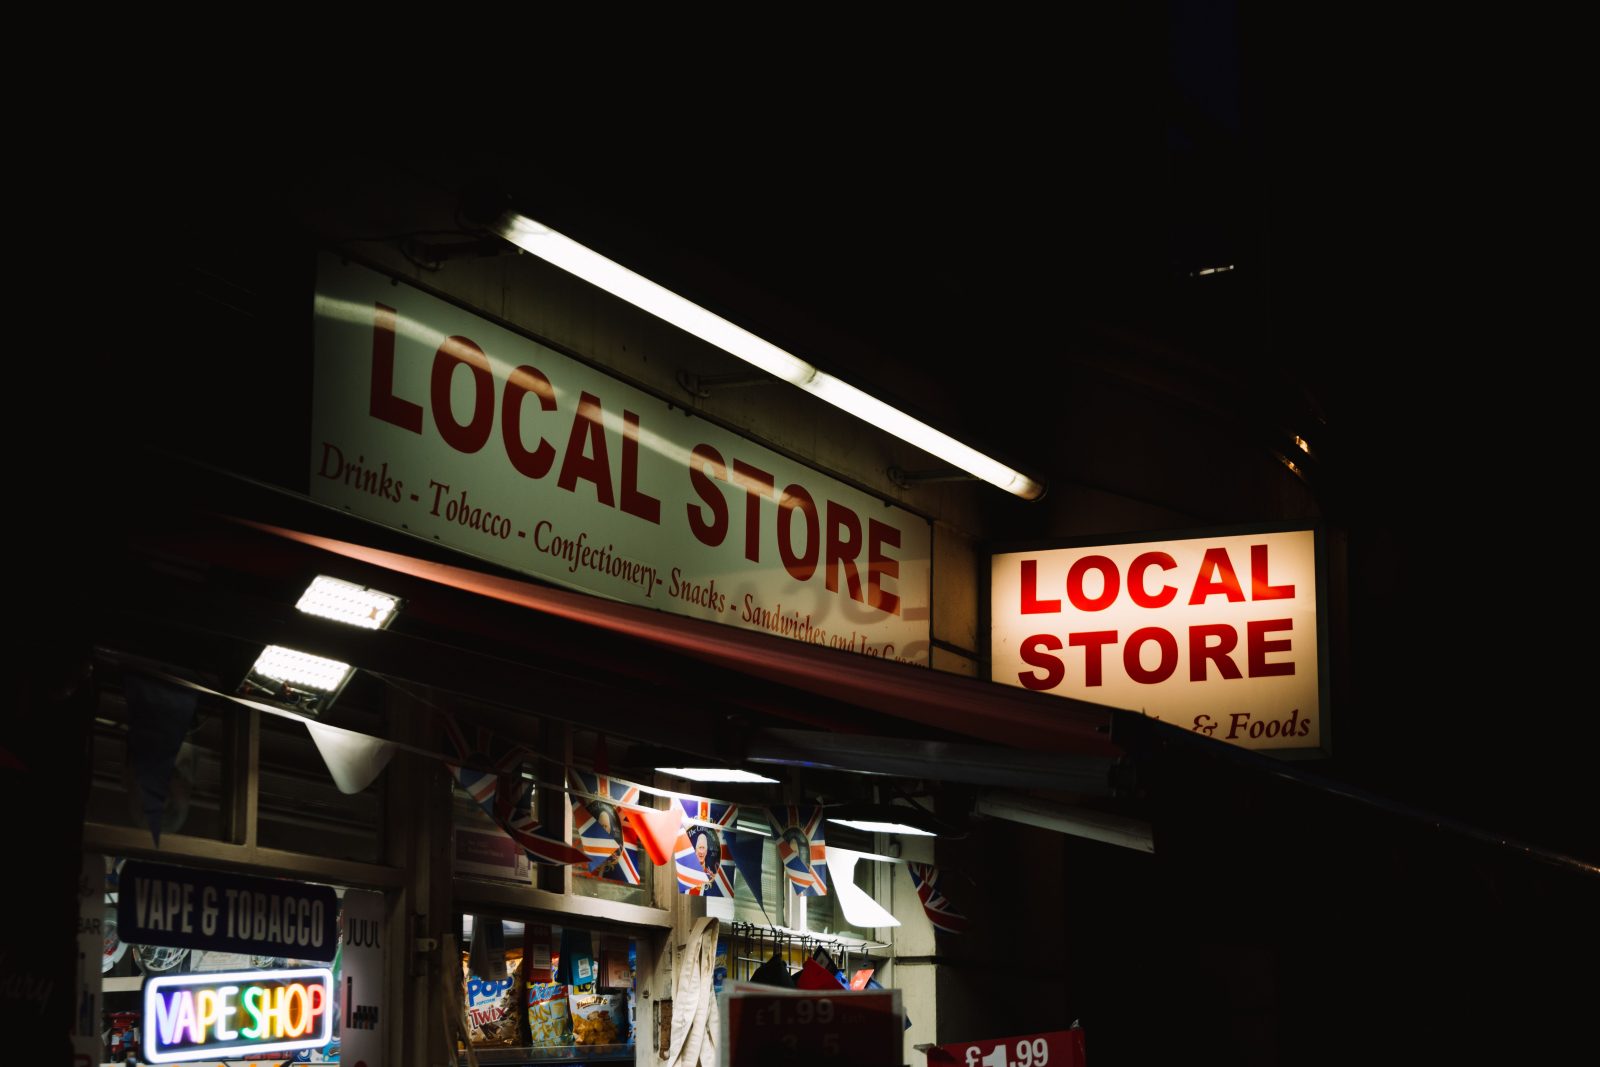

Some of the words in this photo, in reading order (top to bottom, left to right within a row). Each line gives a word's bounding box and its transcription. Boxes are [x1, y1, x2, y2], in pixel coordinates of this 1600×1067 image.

[370, 301, 661, 525] LOCAL
[686, 442, 903, 616] STORE
[318, 441, 405, 504] Drinks
[428, 479, 512, 541] Tobacco
[667, 567, 726, 614] Snacks
[742, 593, 826, 648] Sandwiches
[830, 631, 856, 654] and
[1020, 544, 1295, 615] LOCAL
[1018, 618, 1295, 691] STORE
[1225, 709, 1311, 740] Foods
[134, 877, 193, 934] VAPE
[201, 885, 219, 936] &
[225, 888, 324, 949] TOBACCO
[346, 917, 380, 949] JUUL
[155, 985, 239, 1045] VAPE
[241, 983, 326, 1040] SHOP
[467, 977, 513, 1008] POP
[470, 1005, 508, 1026] Twix
[755, 998, 834, 1026] £1.99
[965, 1038, 1049, 1067] £1.99
